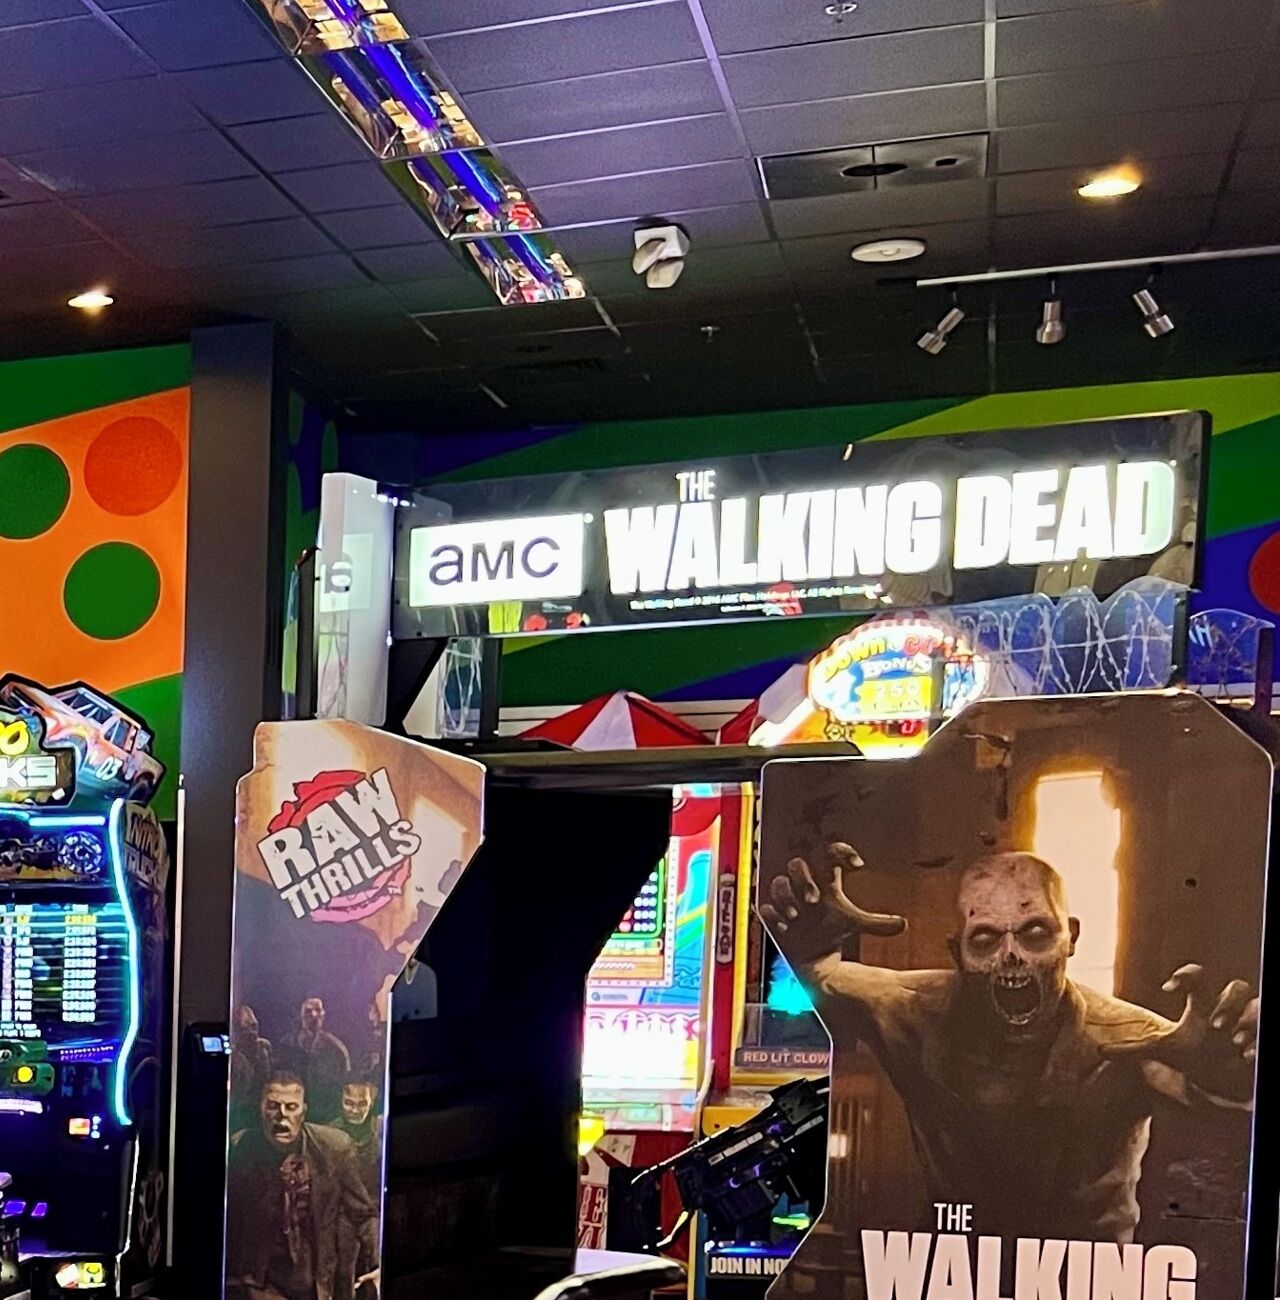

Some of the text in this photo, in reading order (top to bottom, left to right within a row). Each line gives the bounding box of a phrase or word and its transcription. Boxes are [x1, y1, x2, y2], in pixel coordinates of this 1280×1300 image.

[677, 469, 716, 502] THE
[604, 460, 1174, 595] WALKING DEAD
[257, 767, 401, 890] RAW
[280, 820, 421, 919] THRILLS
[743, 1051, 829, 1064] RED LIT CLOW
[934, 1203, 973, 1232] THE
[711, 1257, 789, 1275] JOIN IN NO
